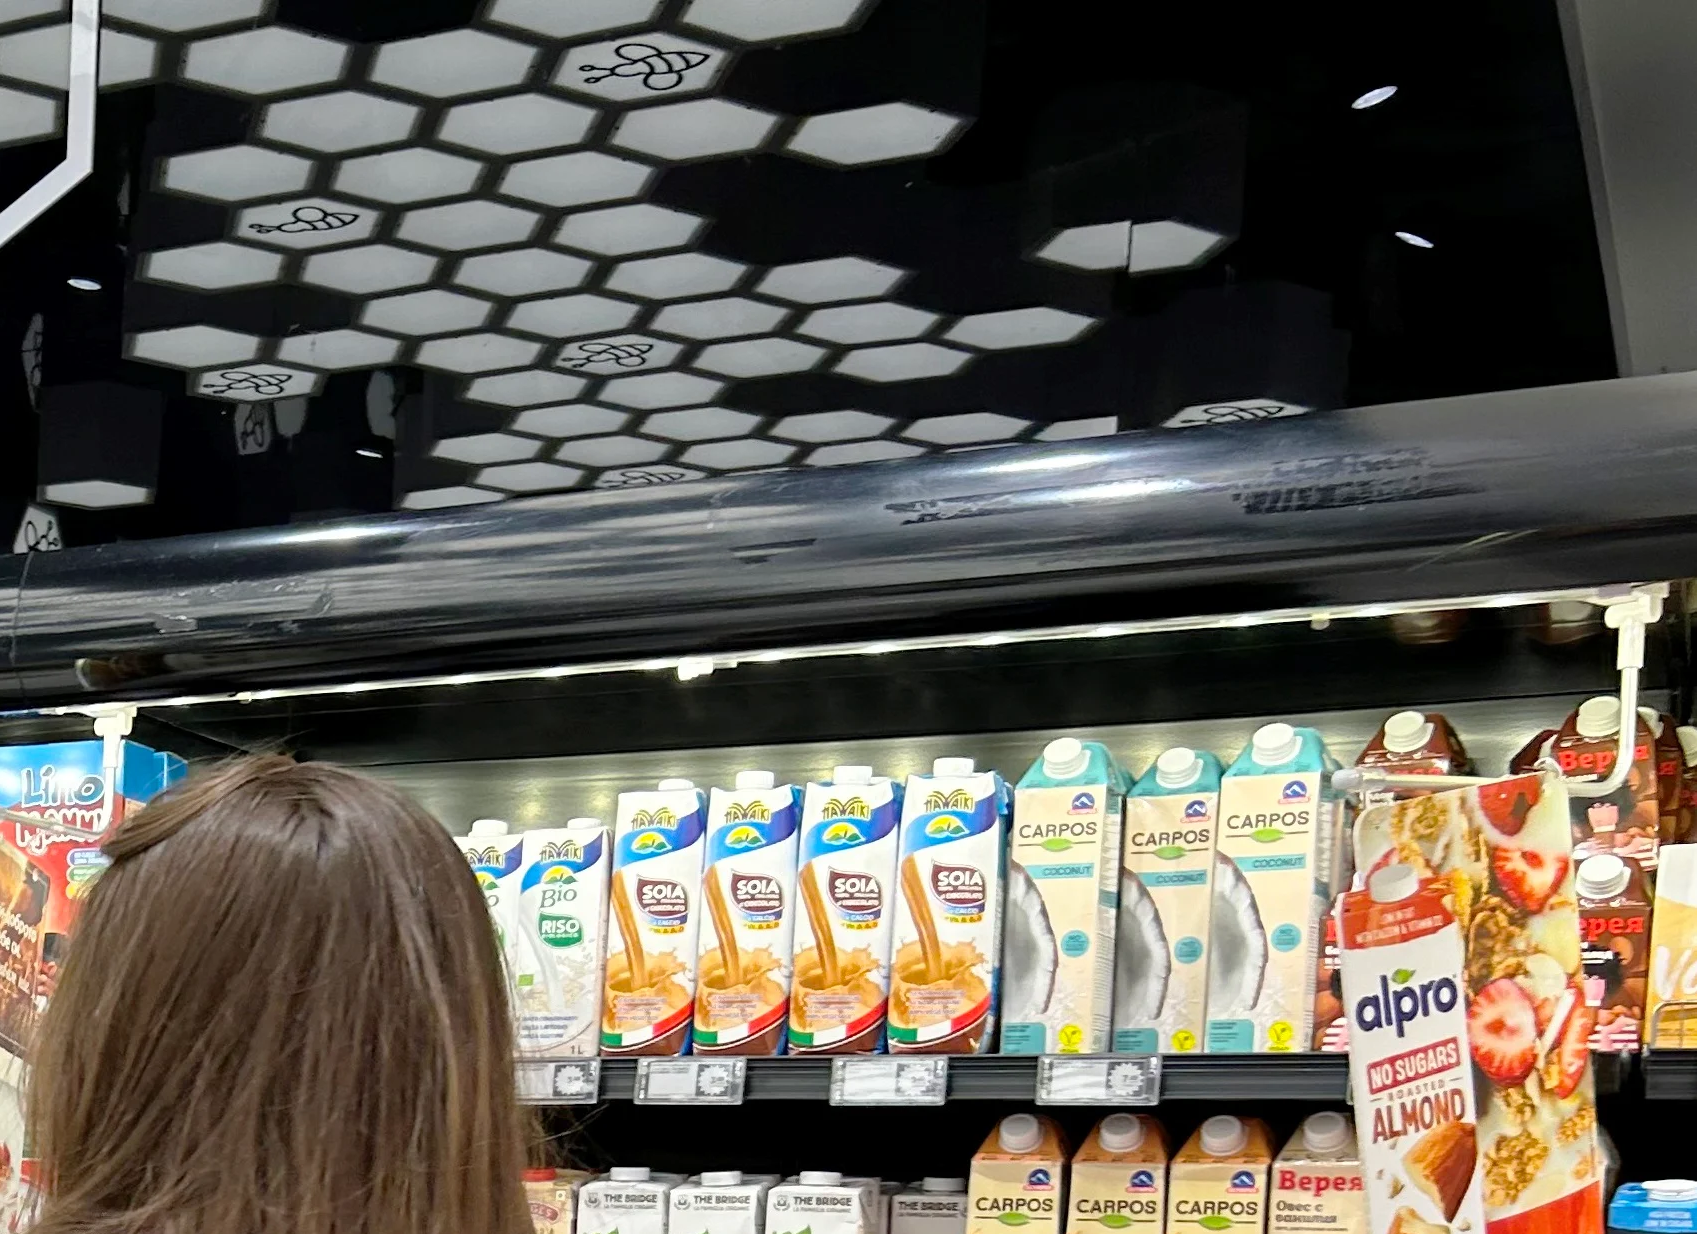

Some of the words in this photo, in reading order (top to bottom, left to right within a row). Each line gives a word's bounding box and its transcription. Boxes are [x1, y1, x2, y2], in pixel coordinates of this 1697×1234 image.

[1226, 811, 1310, 831] CARPOS
[1019, 822, 1097, 841] CARPOS
[1043, 864, 1091, 877] COCONUT
[642, 884, 685, 900] SOIA
[736, 875, 780, 894] SOIA
[540, 886, 577, 909] Bio
[540, 914, 580, 934] RISO
[1356, 975, 1458, 1038] alpro
[1370, 1060, 1392, 1087] NO
[1395, 1041, 1457, 1081] SUGARS
[1372, 1086, 1467, 1144] ALMOND
[1278, 1170, 1364, 1197] Верея
[604, 1194, 623, 1204] THE
[625, 1194, 658, 1205] BRIDGE
[694, 1194, 713, 1205] THE
[716, 1195, 750, 1206] BRIDGE
[794, 1196, 813, 1207] THE
[815, 1197, 852, 1208] BRIDGE
[975, 1197, 1053, 1214] CARPOS
[1175, 1200, 1258, 1217] CARPOS
[1276, 1200, 1312, 1212] Овес
